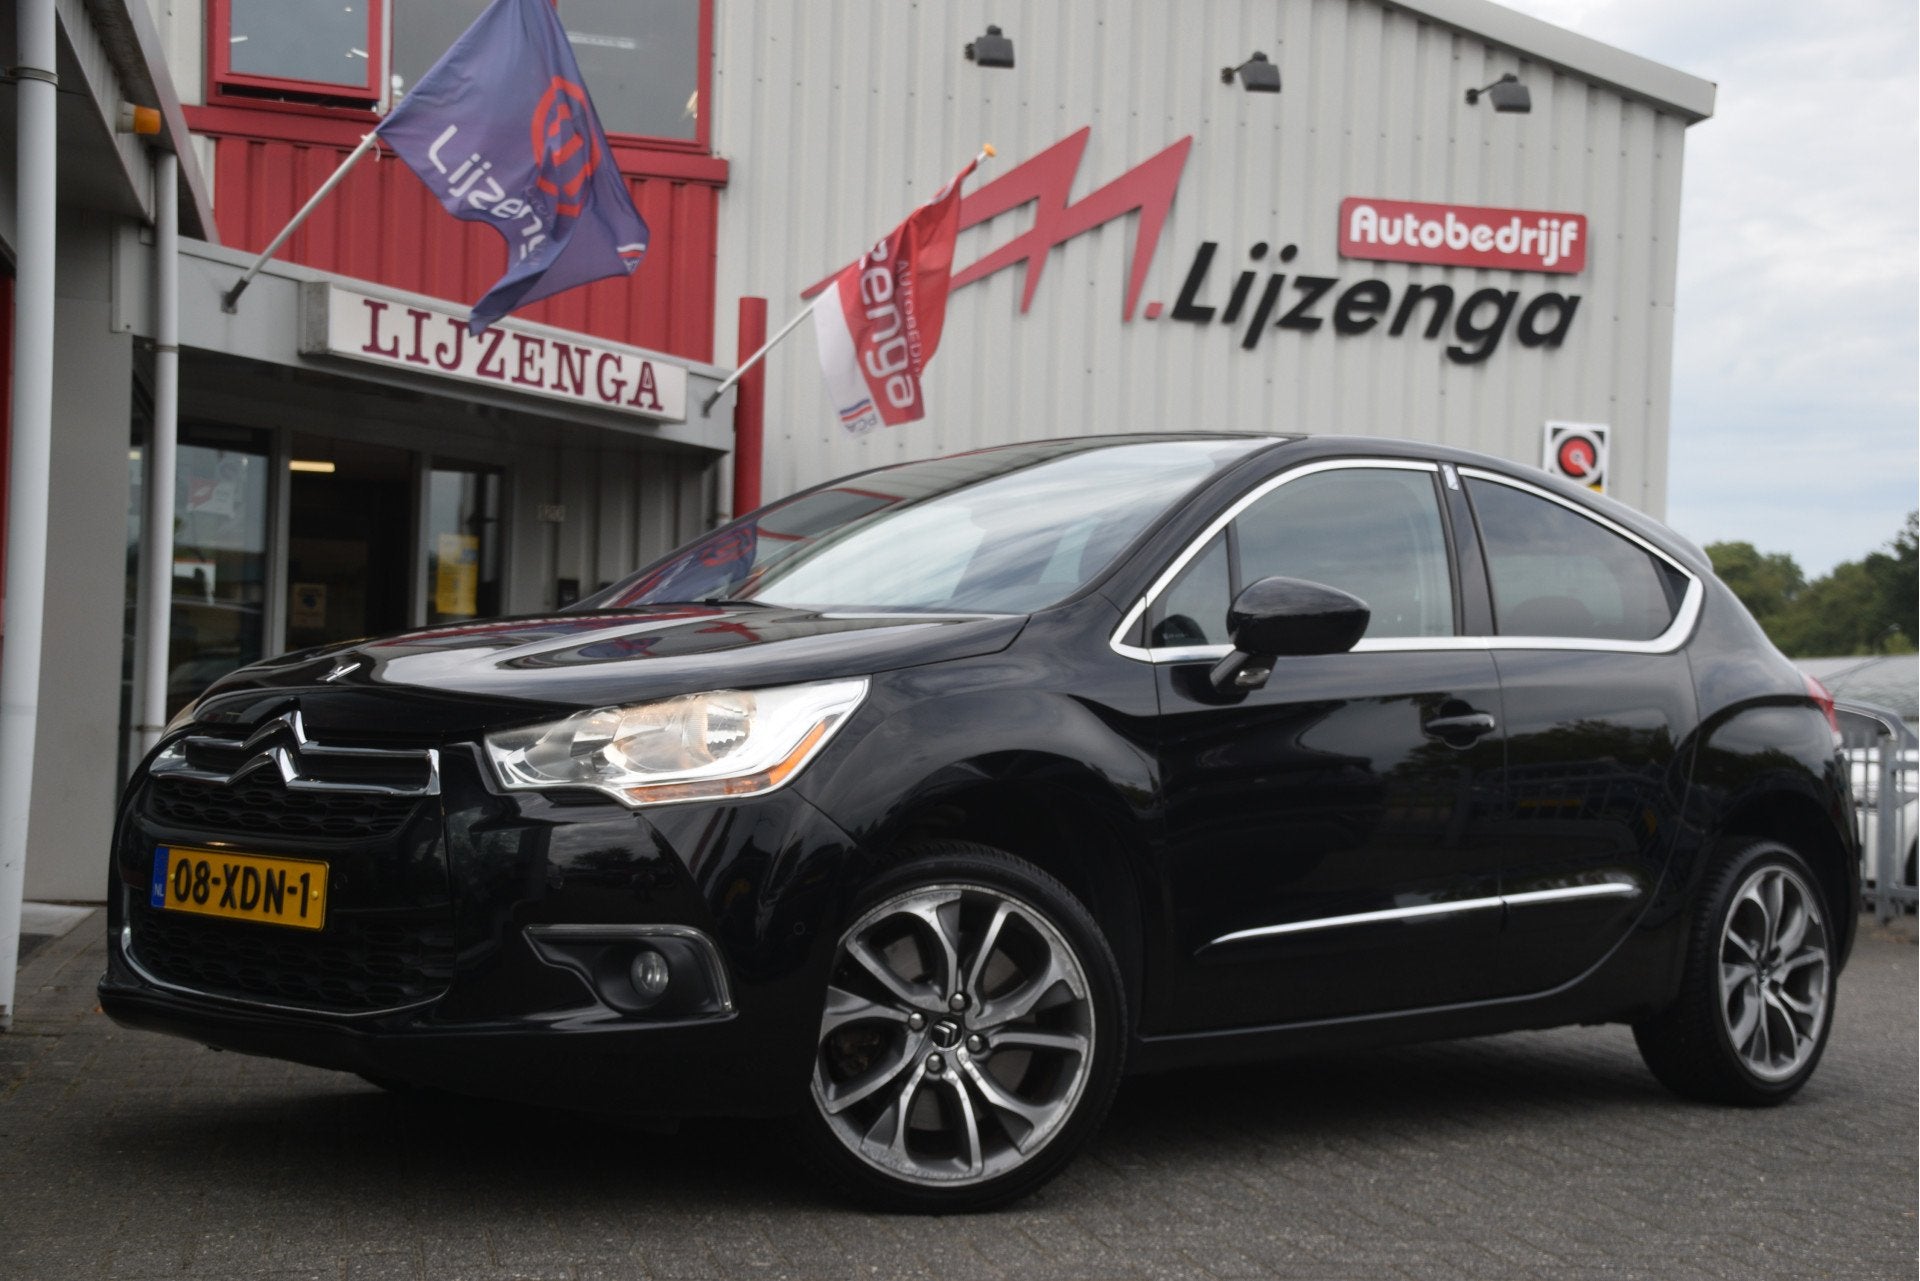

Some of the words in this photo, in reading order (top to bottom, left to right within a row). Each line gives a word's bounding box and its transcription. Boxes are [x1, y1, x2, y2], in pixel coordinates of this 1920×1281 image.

[1349, 205, 1578, 266] Autobedrijf
[1170, 242, 1581, 364] Lijzenga
[362, 299, 664, 412] LIJZENGA
[154, 883, 164, 897] NL
[174, 858, 311, 918] 08-XDN-1
